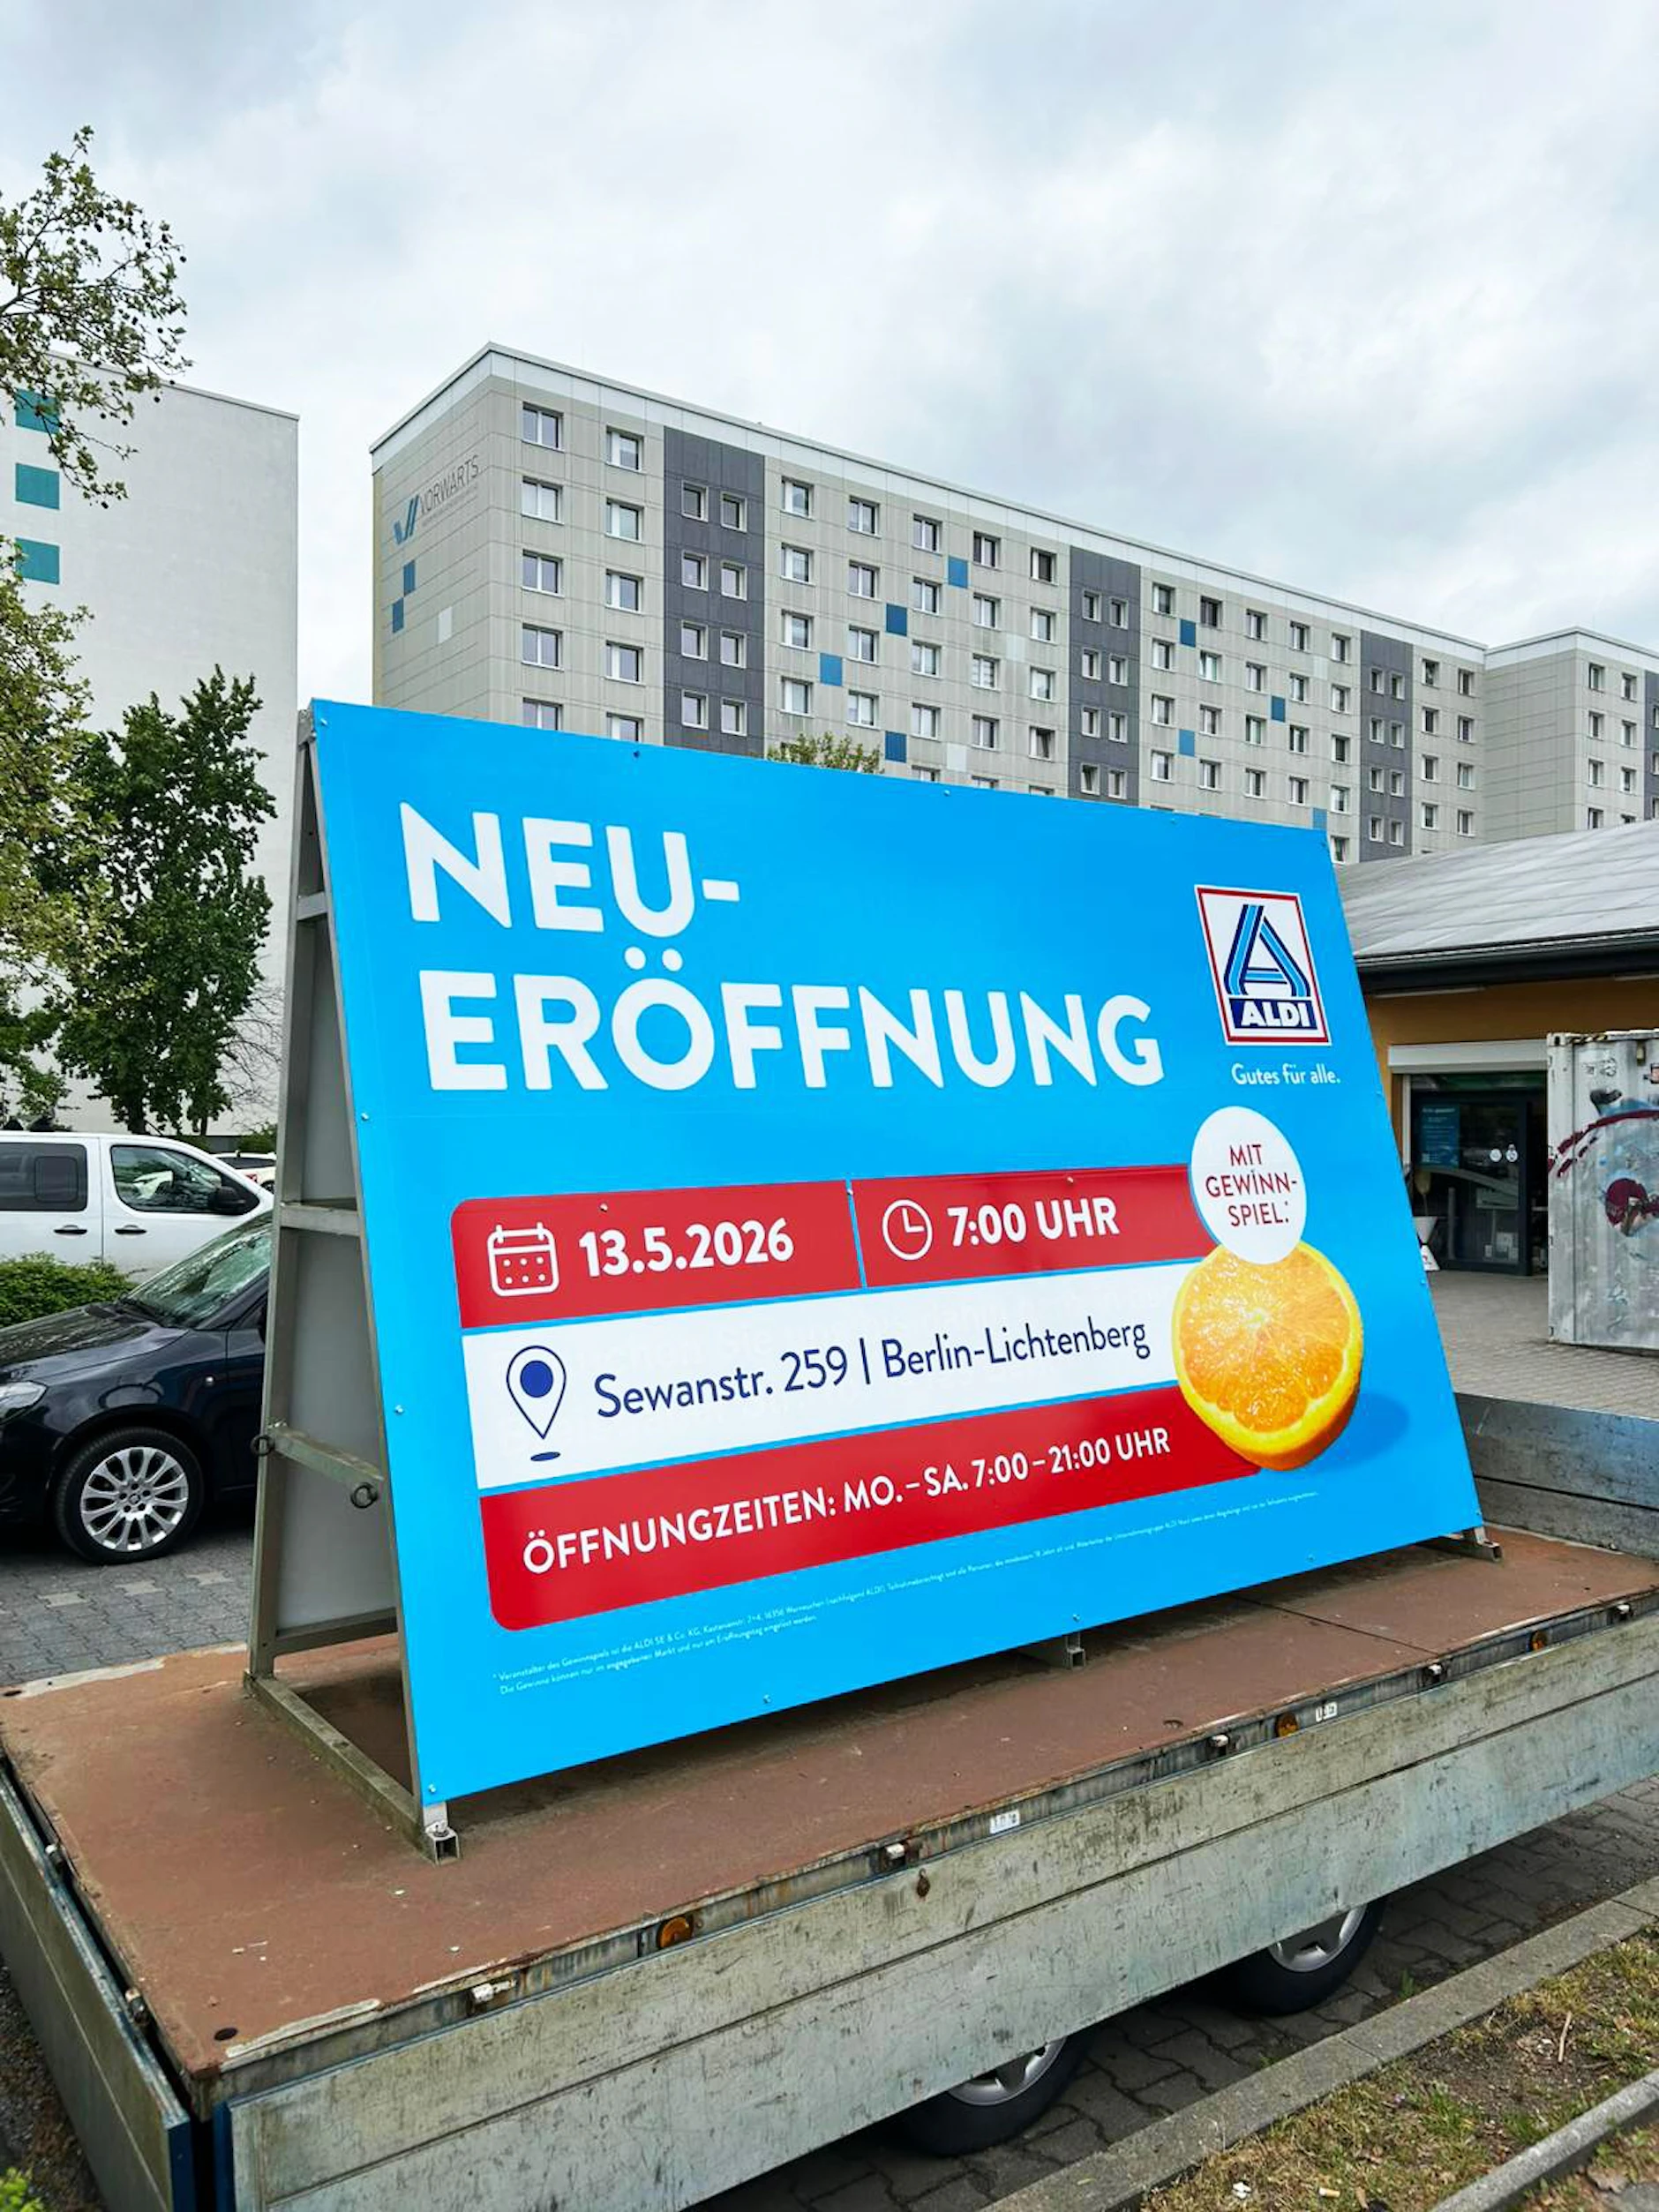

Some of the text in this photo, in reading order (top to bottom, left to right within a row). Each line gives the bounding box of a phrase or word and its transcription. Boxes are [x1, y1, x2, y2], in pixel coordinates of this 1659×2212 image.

[402, 802, 739, 937] NEU-
[420, 947, 1164, 1091] ERÖFFNUNG
[1241, 1001, 1311, 1027] ALDI
[1231, 1063, 1341, 1085] Gutes für alle.
[1229, 1143, 1262, 1166] MIT
[1205, 1173, 1297, 1198] GEWINN-
[579, 1217, 794, 1278] 13.5.2026
[947, 1196, 1120, 1247] 7:00 UHR
[594, 1367, 773, 1418] Sewanstr.
[781, 1346, 848, 1392] 259
[882, 1316, 1151, 1378] Berlin-Lichtenberg
[523, 1487, 837, 1574] ÖFFNUNGZEITEN:
[844, 1475, 903, 1512] MO.
[924, 1464, 969, 1497] SA.
[972, 1452, 1028, 1488] 7:00
[1048, 1437, 1111, 1473] 21:00
[1115, 1427, 1171, 1461] UHR
